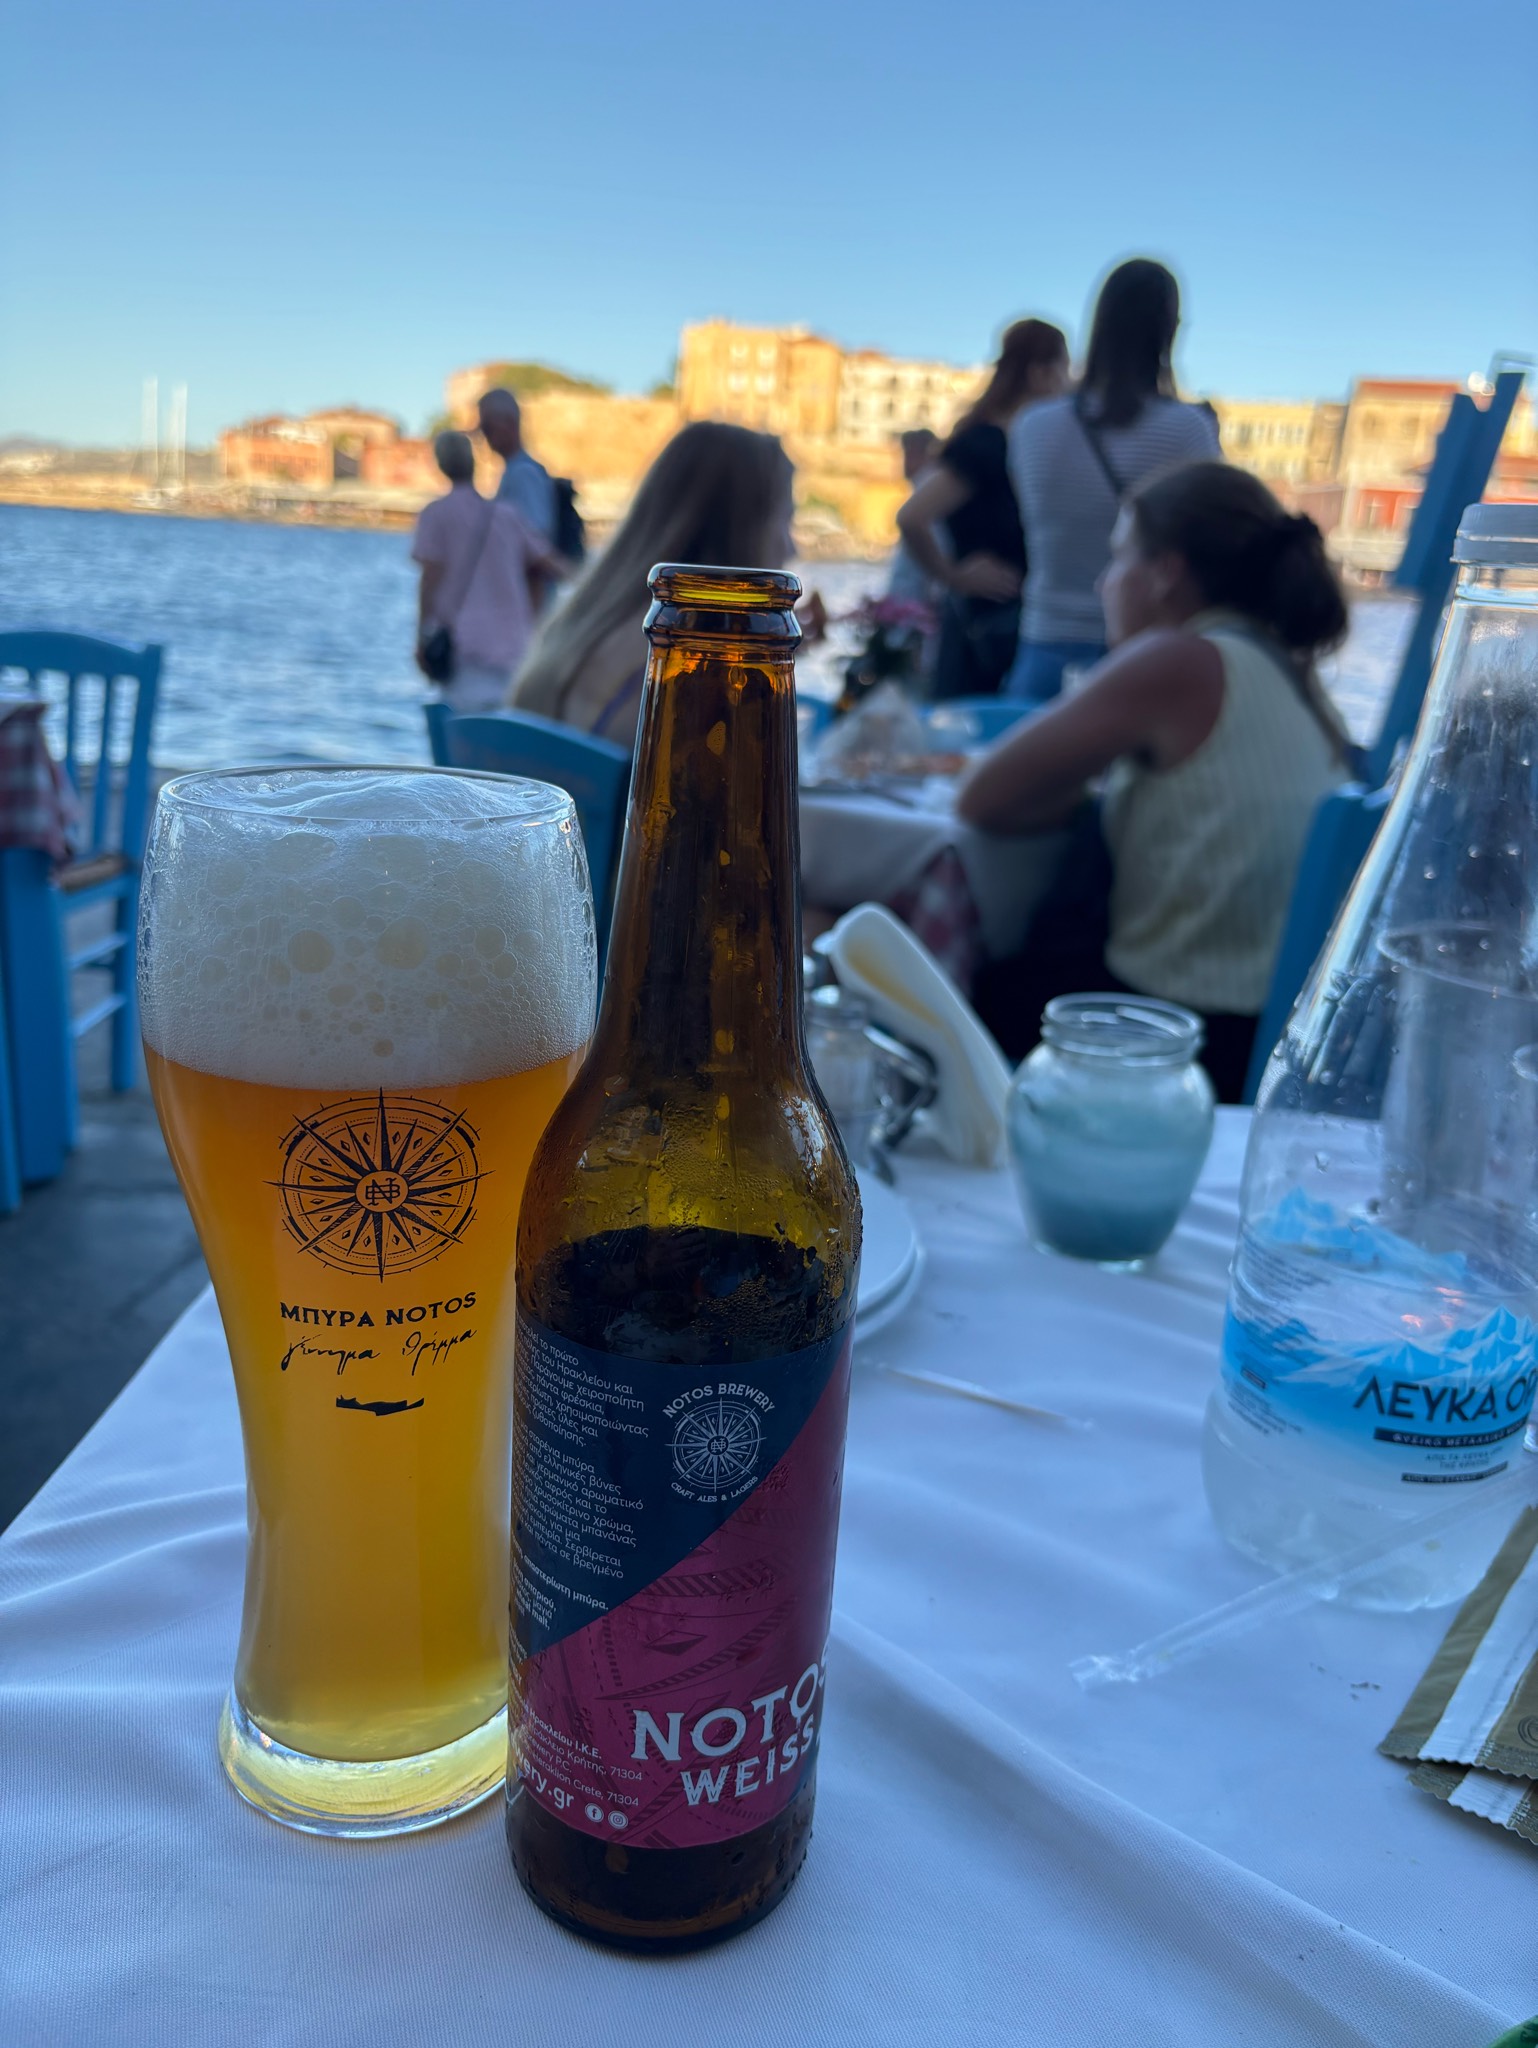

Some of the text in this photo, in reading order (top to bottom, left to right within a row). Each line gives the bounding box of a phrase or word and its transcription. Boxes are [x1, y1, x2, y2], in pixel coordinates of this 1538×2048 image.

[279, 1291, 478, 1328] ΜΠΥΡΑ NOTOS
[540, 1338, 549, 1352] το
[550, 1345, 579, 1367] πρώτο
[531, 1354, 574, 1390] Παράγουμε
[577, 1384, 645, 1412] χειροποίητη
[541, 1351, 555, 1368] του
[557, 1361, 611, 1390] Ηρακλείου
[614, 1382, 634, 1395] και
[536, 1375, 559, 1396] πάντα
[561, 1390, 605, 1415] φρέσκια,
[662, 1383, 776, 1418] NOTOS BREWERY
[1352, 1375, 1498, 1423] ΛΕΥΚΑ
[530, 1393, 557, 1421] πρώτες
[558, 1410, 579, 1432] ύλες
[581, 1426, 599, 1437] και
[532, 1407, 587, 1447] ζυθοποίησης.
[555, 1400, 649, 1438] χρησιμοποιώντας
[543, 1453, 587, 1486] ελληνικές
[589, 1476, 622, 1495] βύνες
[562, 1453, 595, 1474] μπύρα
[536, 1459, 579, 1492] γερμανικό
[581, 1487, 644, 1510] αρωματικό
[544, 1481, 573, 1504] αφρός
[575, 1496, 592, 1510] και
[594, 1503, 607, 1514] το
[671, 1482, 696, 1499] CRAFT
[697, 1495, 718, 1503] ALES
[730, 1475, 759, 1498] LAGERS
[533, 1484, 590, 1521] χρυσοκίτρινο
[593, 1515, 634, 1535] χρώμα,
[539, 1500, 579, 1529] αρώματα
[581, 1525, 638, 1548] μπανάνας
[529, 1516, 563, 1544] εμπειρία.
[565, 1537, 622, 1568] Σερβίρεται
[550, 1520, 563, 1533] για
[565, 1529, 581, 1542] μια
[534, 1532, 558, 1553] πάντα
[559, 1550, 571, 1561] σε
[573, 1553, 624, 1579] βρεγμένο
[531, 1607, 551, 1631] malt,
[572, 1592, 609, 1611] μπύρα.
[529, 1709, 602, 1760] Ηρακλείου Ι.Κ.Ε.
[555, 1757, 572, 1773] P.C.
[567, 1750, 607, 1775] Κρήτης,
[610, 1766, 643, 1781] 71304
[573, 1780, 604, 1799] Crete,
[607, 1791, 640, 1807] 71304
